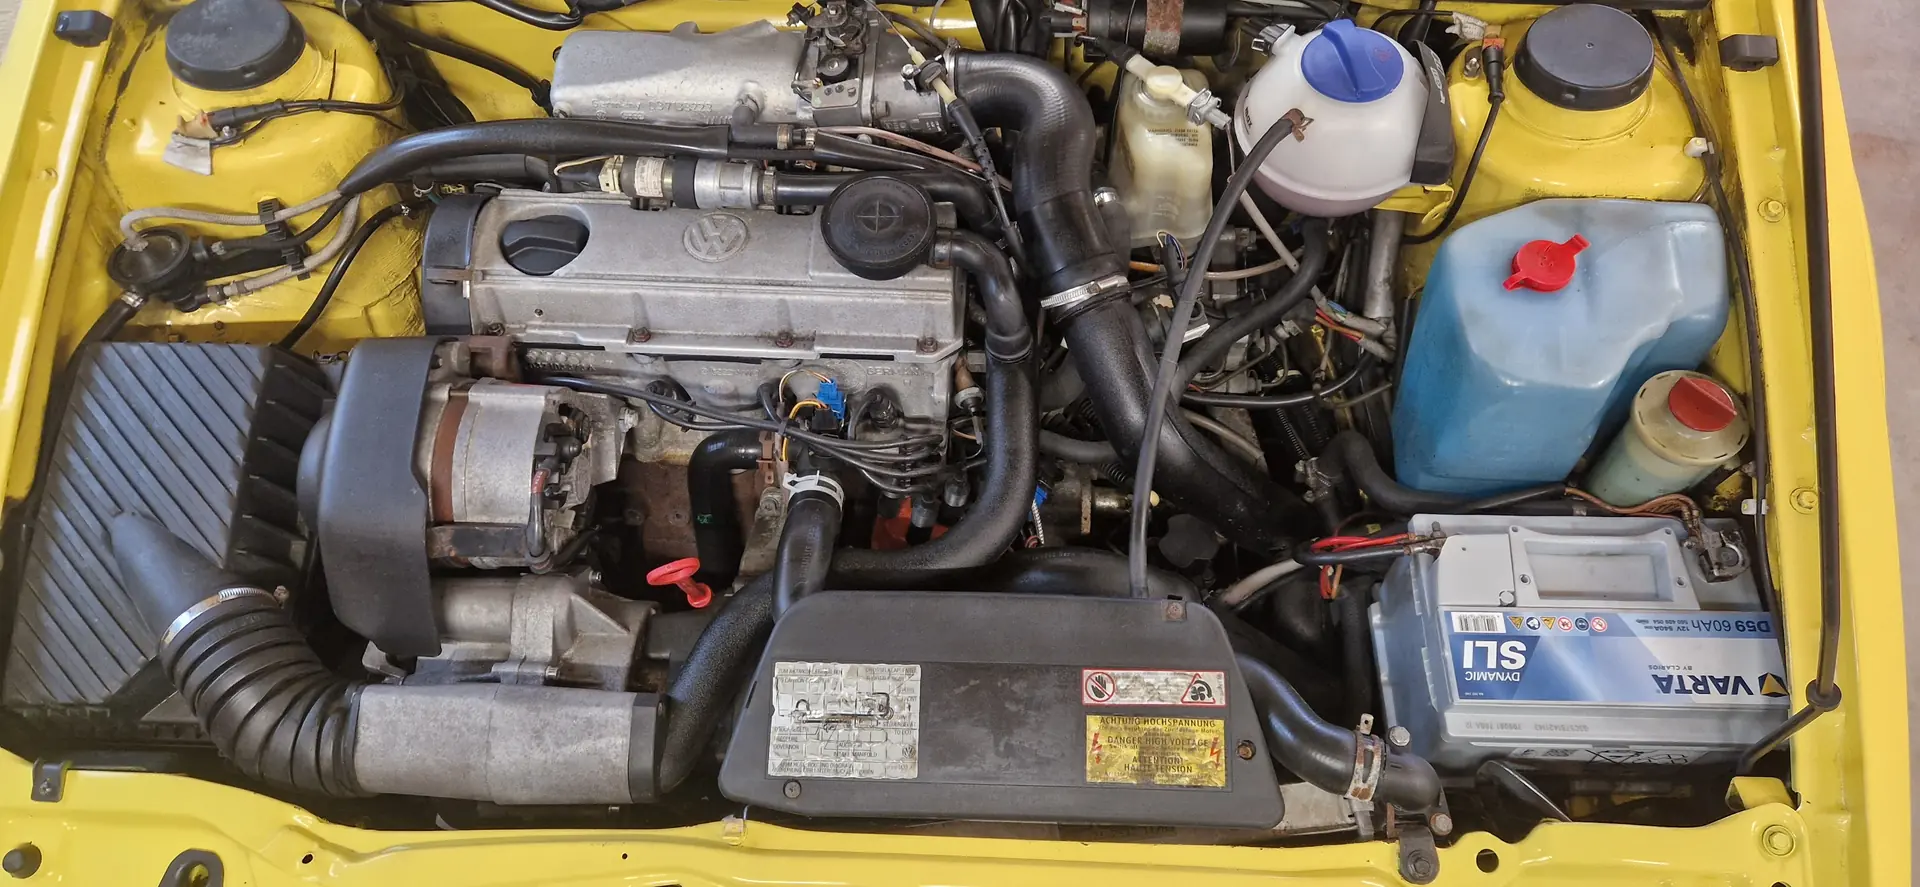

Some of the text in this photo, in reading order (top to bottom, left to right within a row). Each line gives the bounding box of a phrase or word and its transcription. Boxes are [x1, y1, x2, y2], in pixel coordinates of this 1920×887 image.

[1691, 619, 1770, 633] D59 60Ah
[1463, 640, 1527, 670] SLI
[1464, 671, 1520, 682] DYNAMIC
[1651, 673, 1754, 696] VARTA
[1100, 716, 1216, 727] ACHTUNG HOCHSPANNUNG
[1107, 736, 1208, 747] DANGER HIGH VOLTAGE
